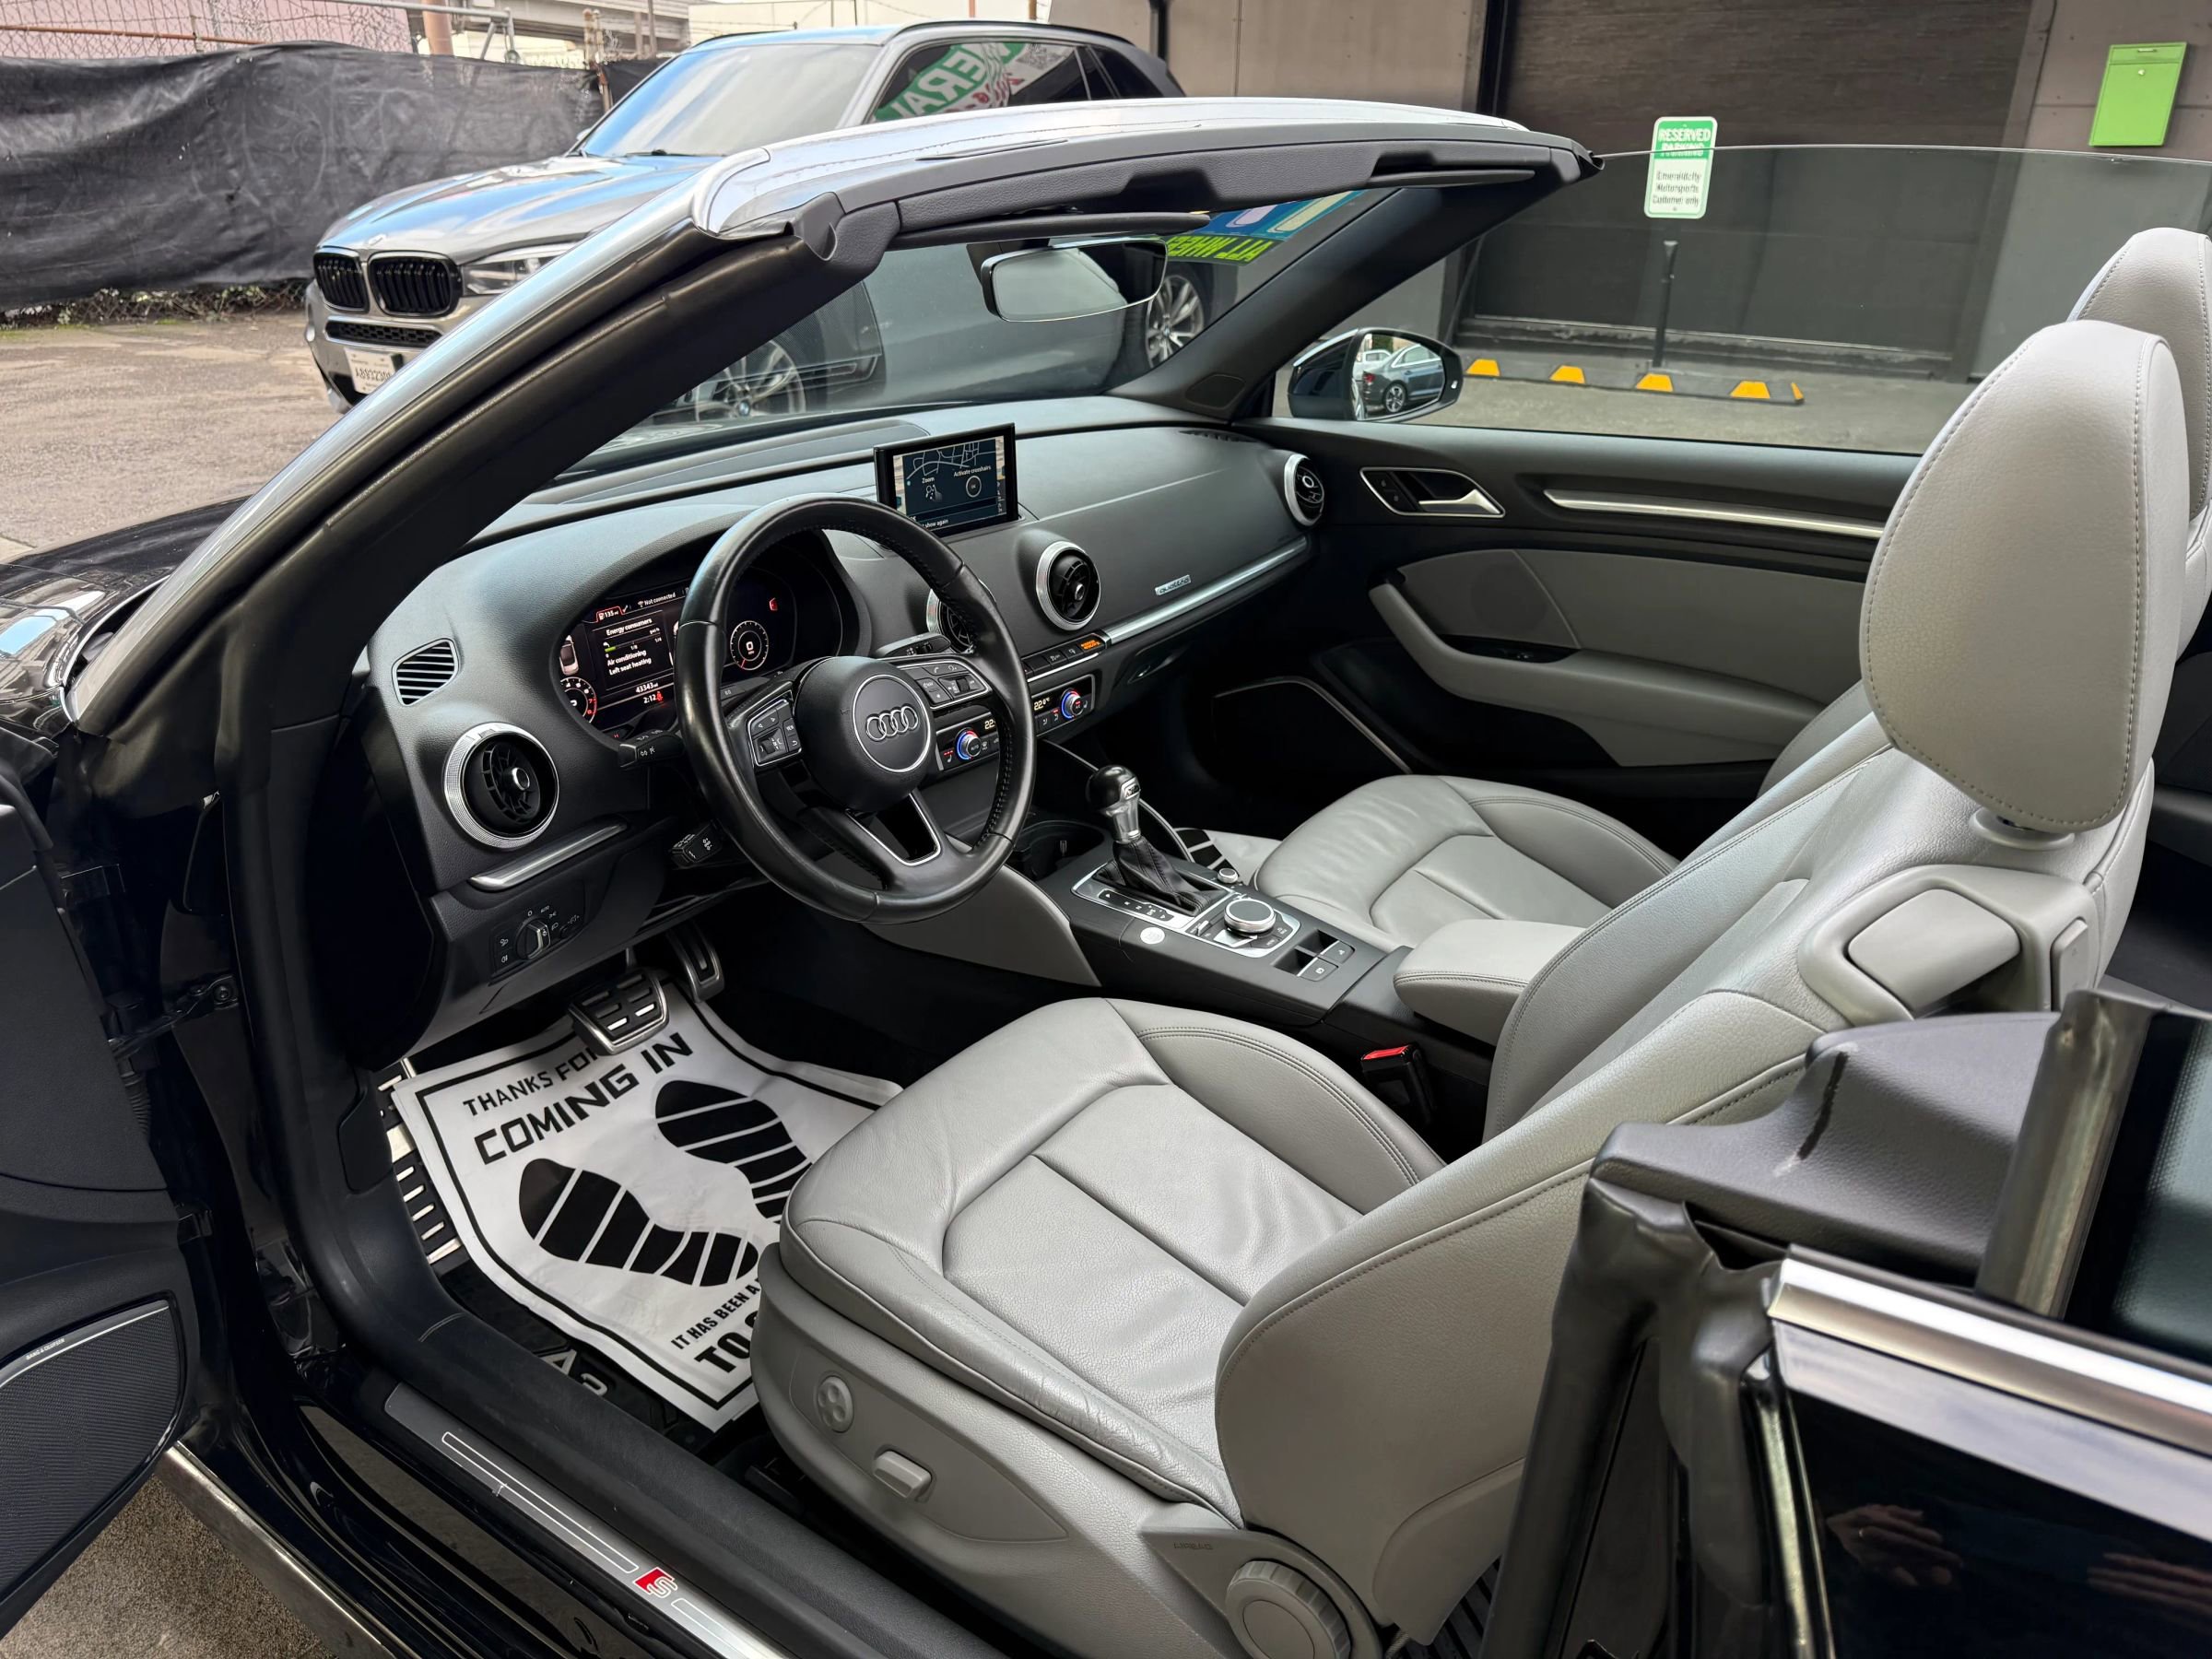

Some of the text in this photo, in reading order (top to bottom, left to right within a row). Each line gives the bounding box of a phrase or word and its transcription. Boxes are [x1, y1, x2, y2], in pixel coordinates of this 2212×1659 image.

[1657, 128, 1712, 142] RESERVED
[653, 592, 677, 604] connected
[605, 610, 615, 618] 135
[606, 618, 653, 636] Energy consumers
[615, 650, 647, 665] conditioning
[608, 657, 653, 676] Left seat heating
[635, 682, 653, 693] 43343
[643, 693, 656, 704] 2:12
[984, 718, 996, 730] 22
[463, 1070, 553, 1117] THANKS
[474, 1031, 694, 1165] COMING IN
[671, 1334, 691, 1350] IT
[686, 1316, 719, 1340] HAS
[712, 1291, 751, 1320] BEEN
[745, 1284, 761, 1296] A
[693, 1331, 751, 1374] TO
